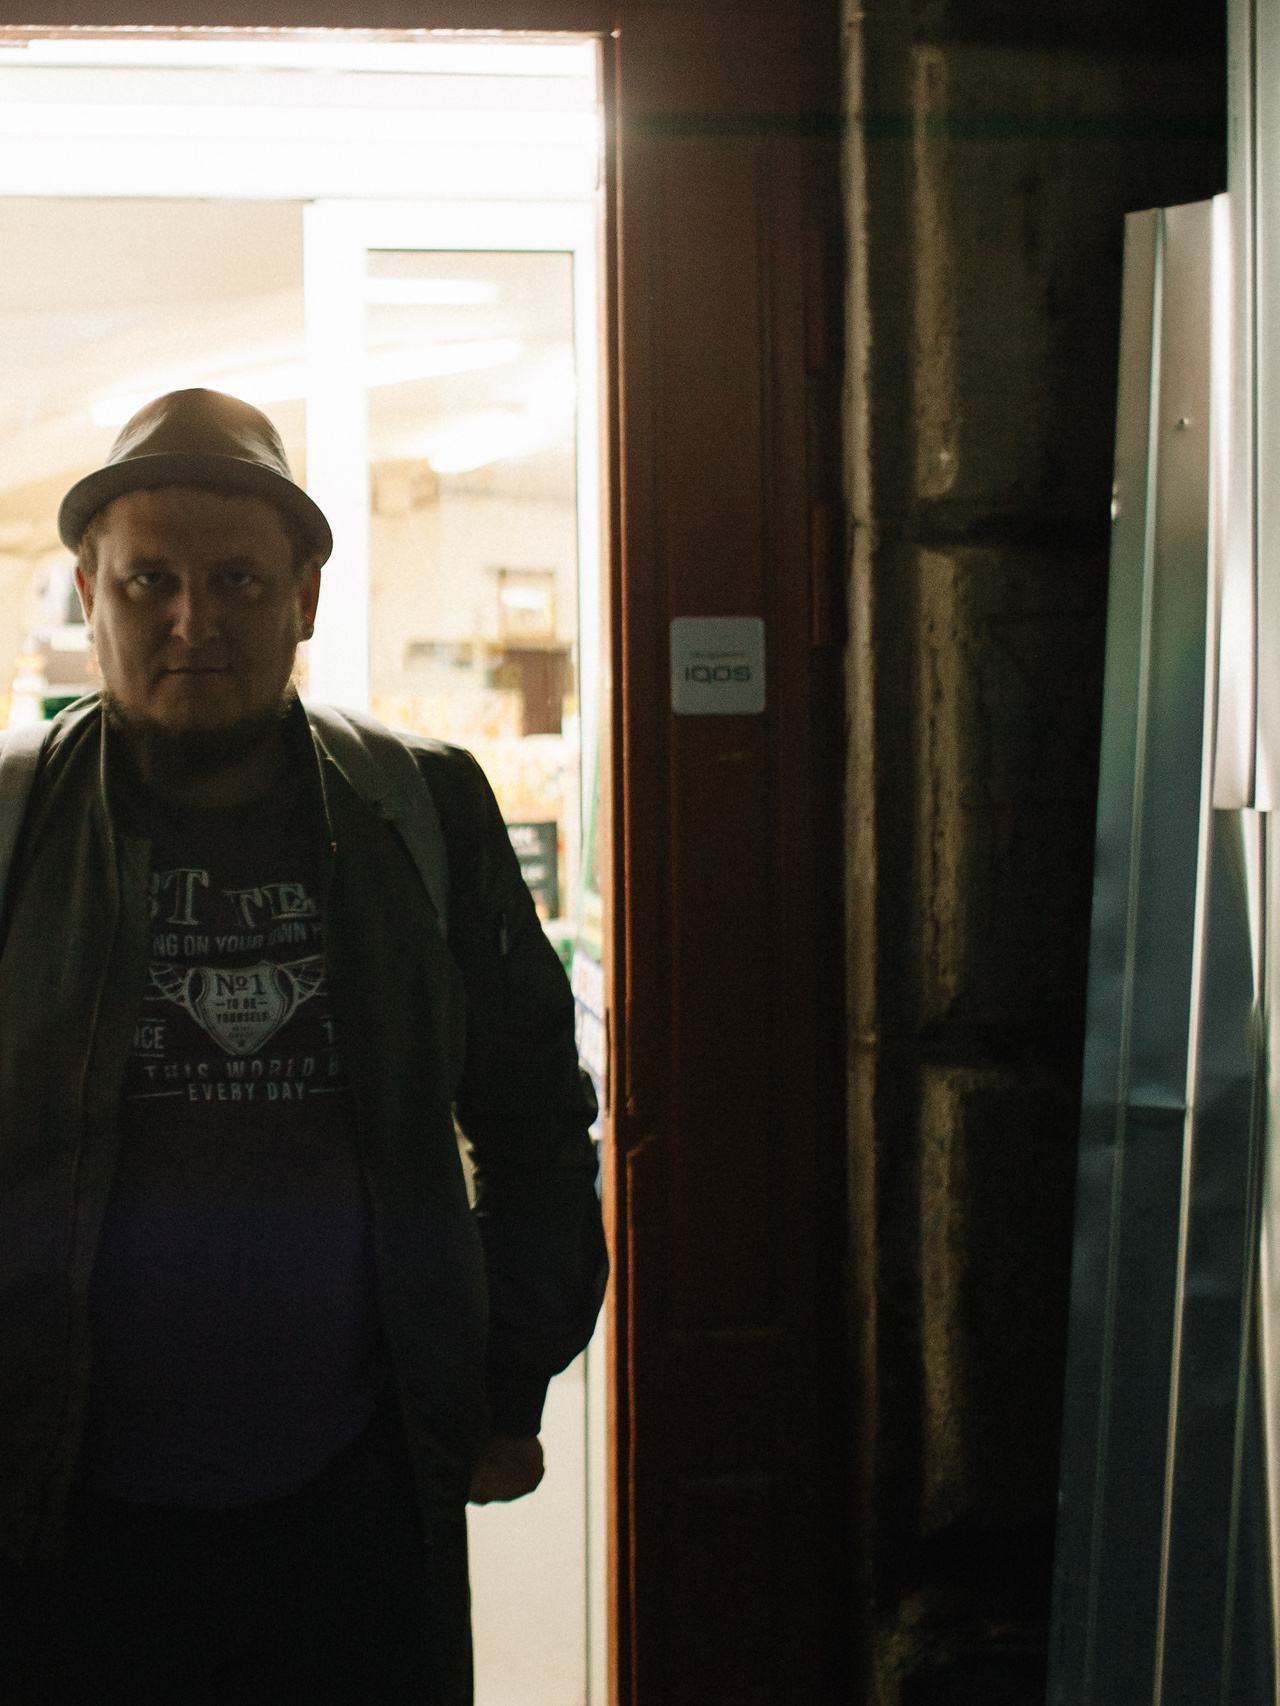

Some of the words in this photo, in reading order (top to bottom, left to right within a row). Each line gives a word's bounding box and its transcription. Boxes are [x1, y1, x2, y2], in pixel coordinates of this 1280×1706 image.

[684, 665, 751, 684] IQOS
[184, 934, 210, 956] ON
[215, 933, 265, 953] YOUR
[267, 922, 308, 947] OWN
[227, 997, 239, 1010] TO
[243, 997, 257, 1010] BE
[216, 1011, 268, 1024] YOURSELF
[144, 1062, 210, 1079] THIS
[225, 1057, 315, 1078] WORLD
[187, 1081, 255, 1102] EVERY
[266, 1081, 305, 1101] DAY
